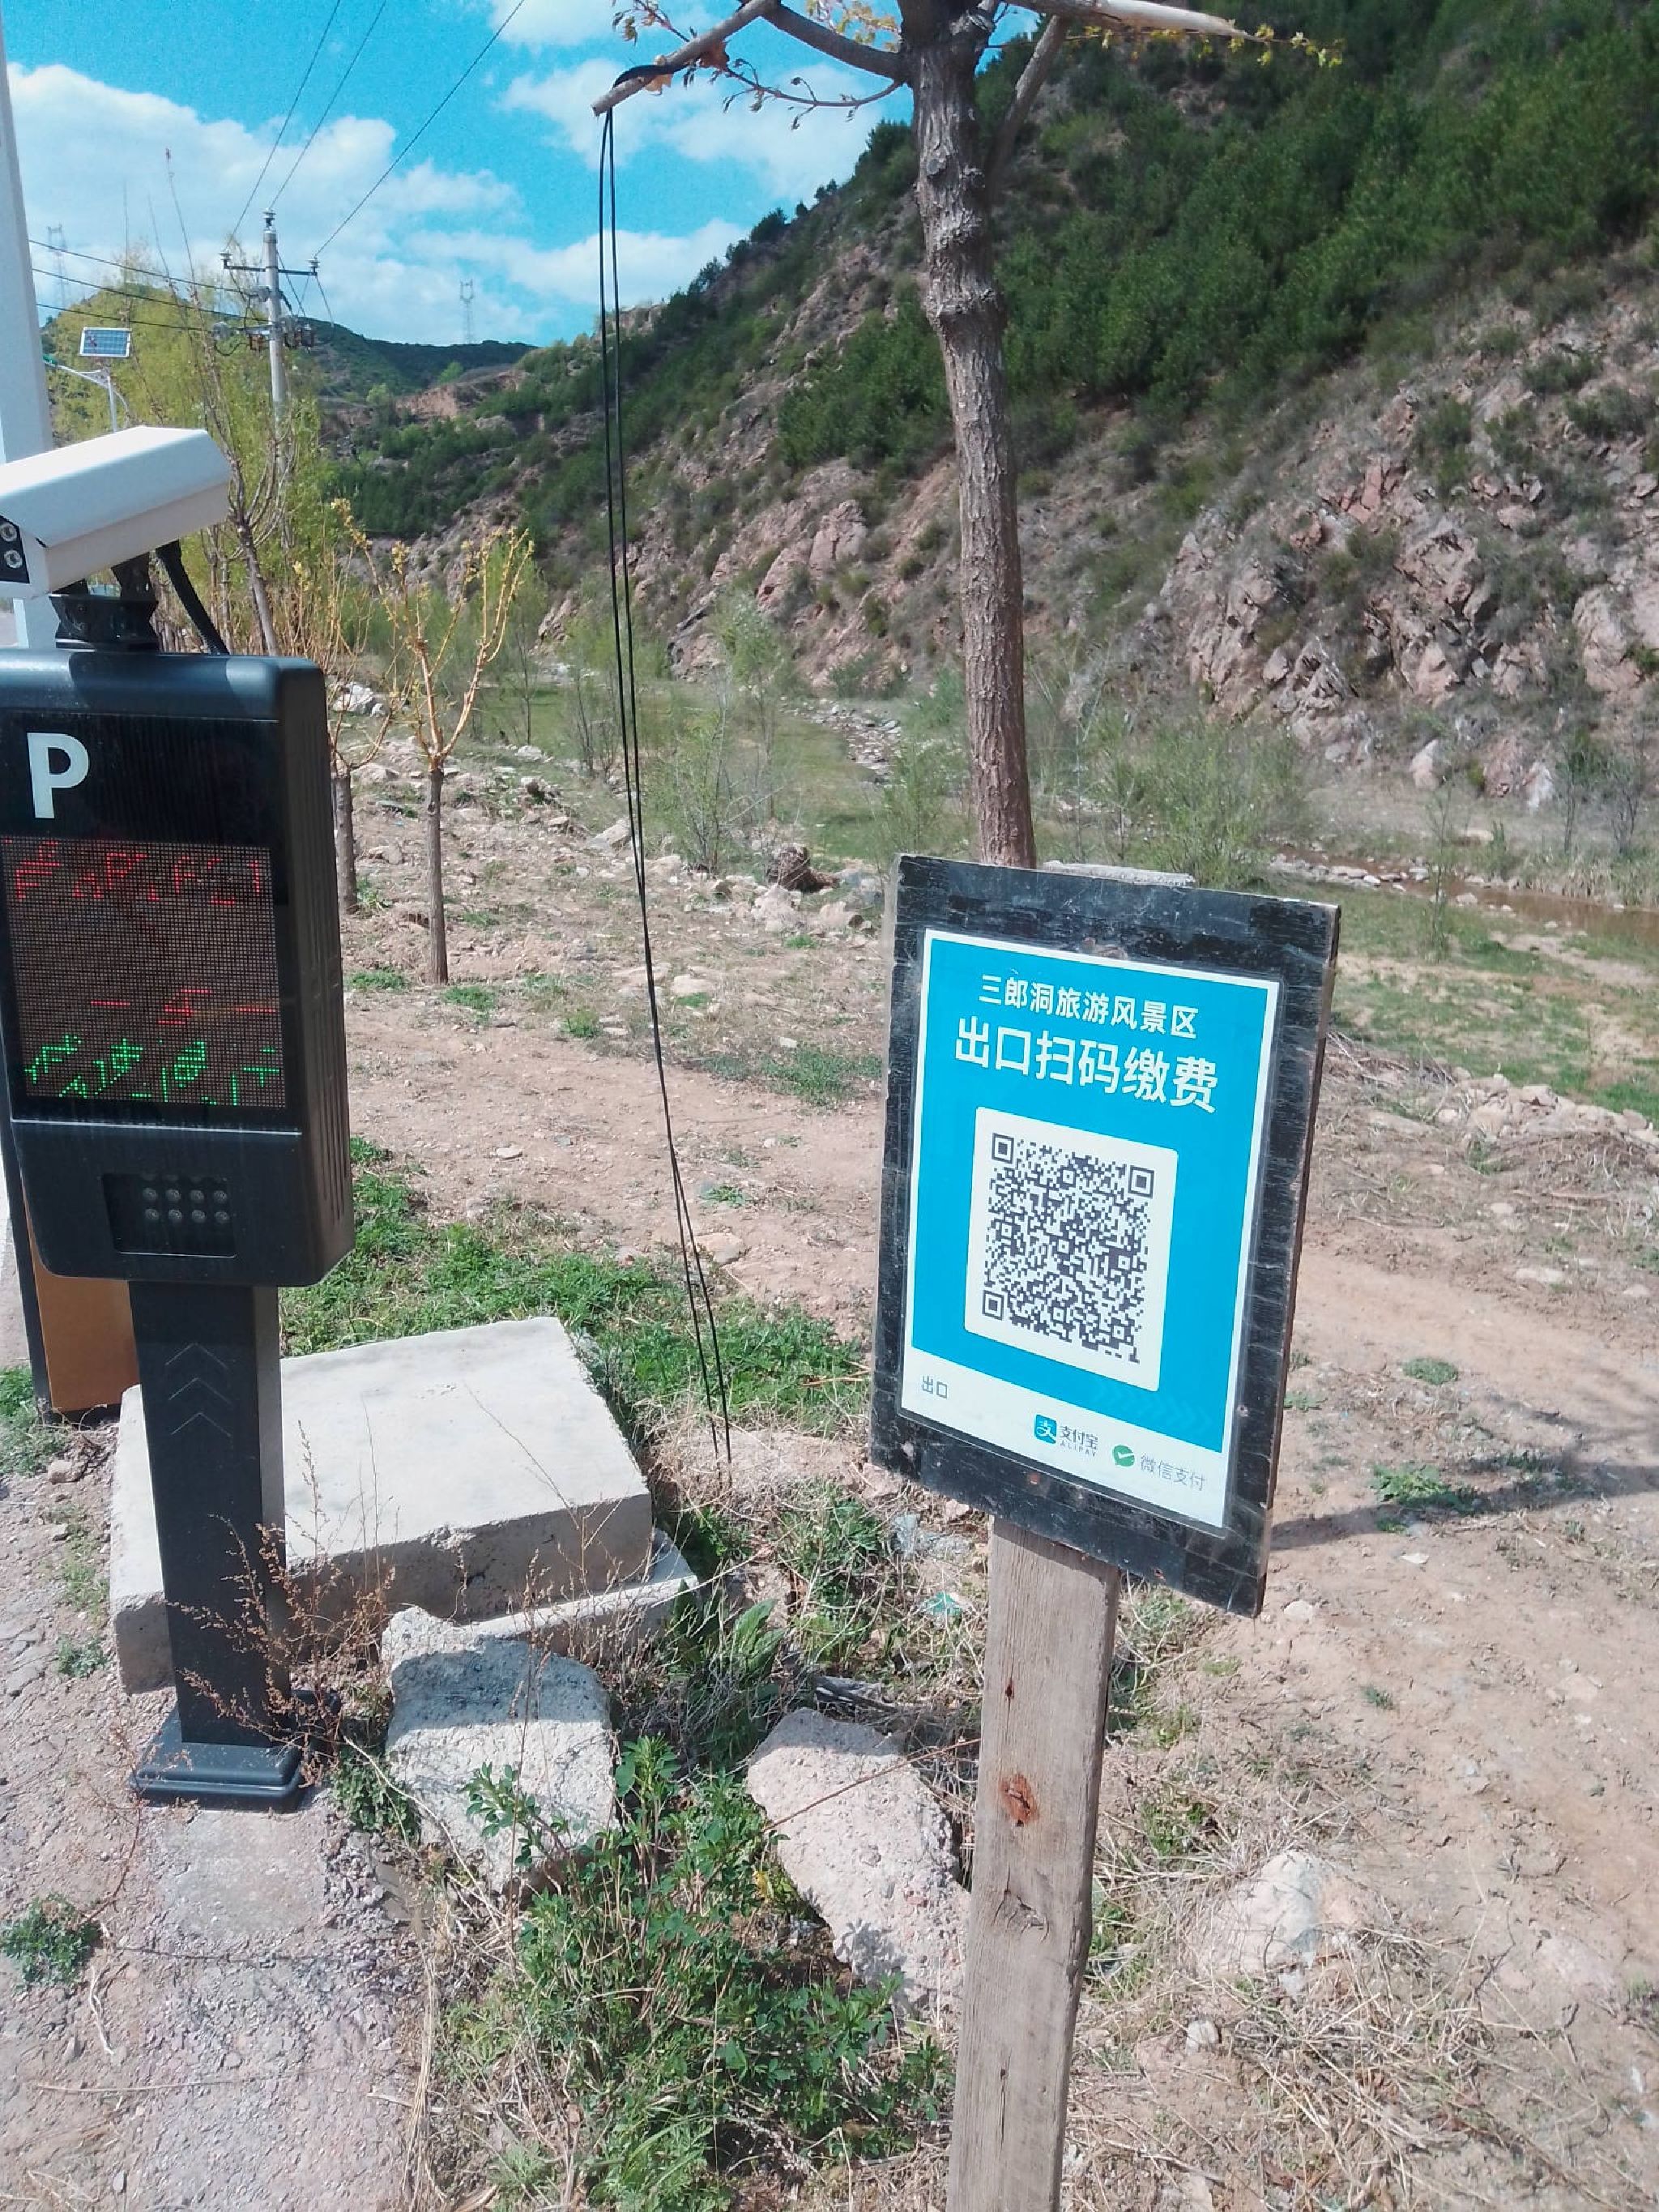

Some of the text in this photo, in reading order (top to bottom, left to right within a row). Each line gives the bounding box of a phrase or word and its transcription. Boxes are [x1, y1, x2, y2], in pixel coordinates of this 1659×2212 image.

[27, 732, 89, 818] P
[979, 974, 1199, 1039] 三郎洞旅游风景区
[955, 1016, 1218, 1113] 出口扫码缴费
[922, 1375, 948, 1399] 出口
[1060, 1425, 1098, 1450] 支付宝
[1060, 1441, 1097, 1458] ALIPAY
[1141, 1453, 1205, 1492] 微信支付
